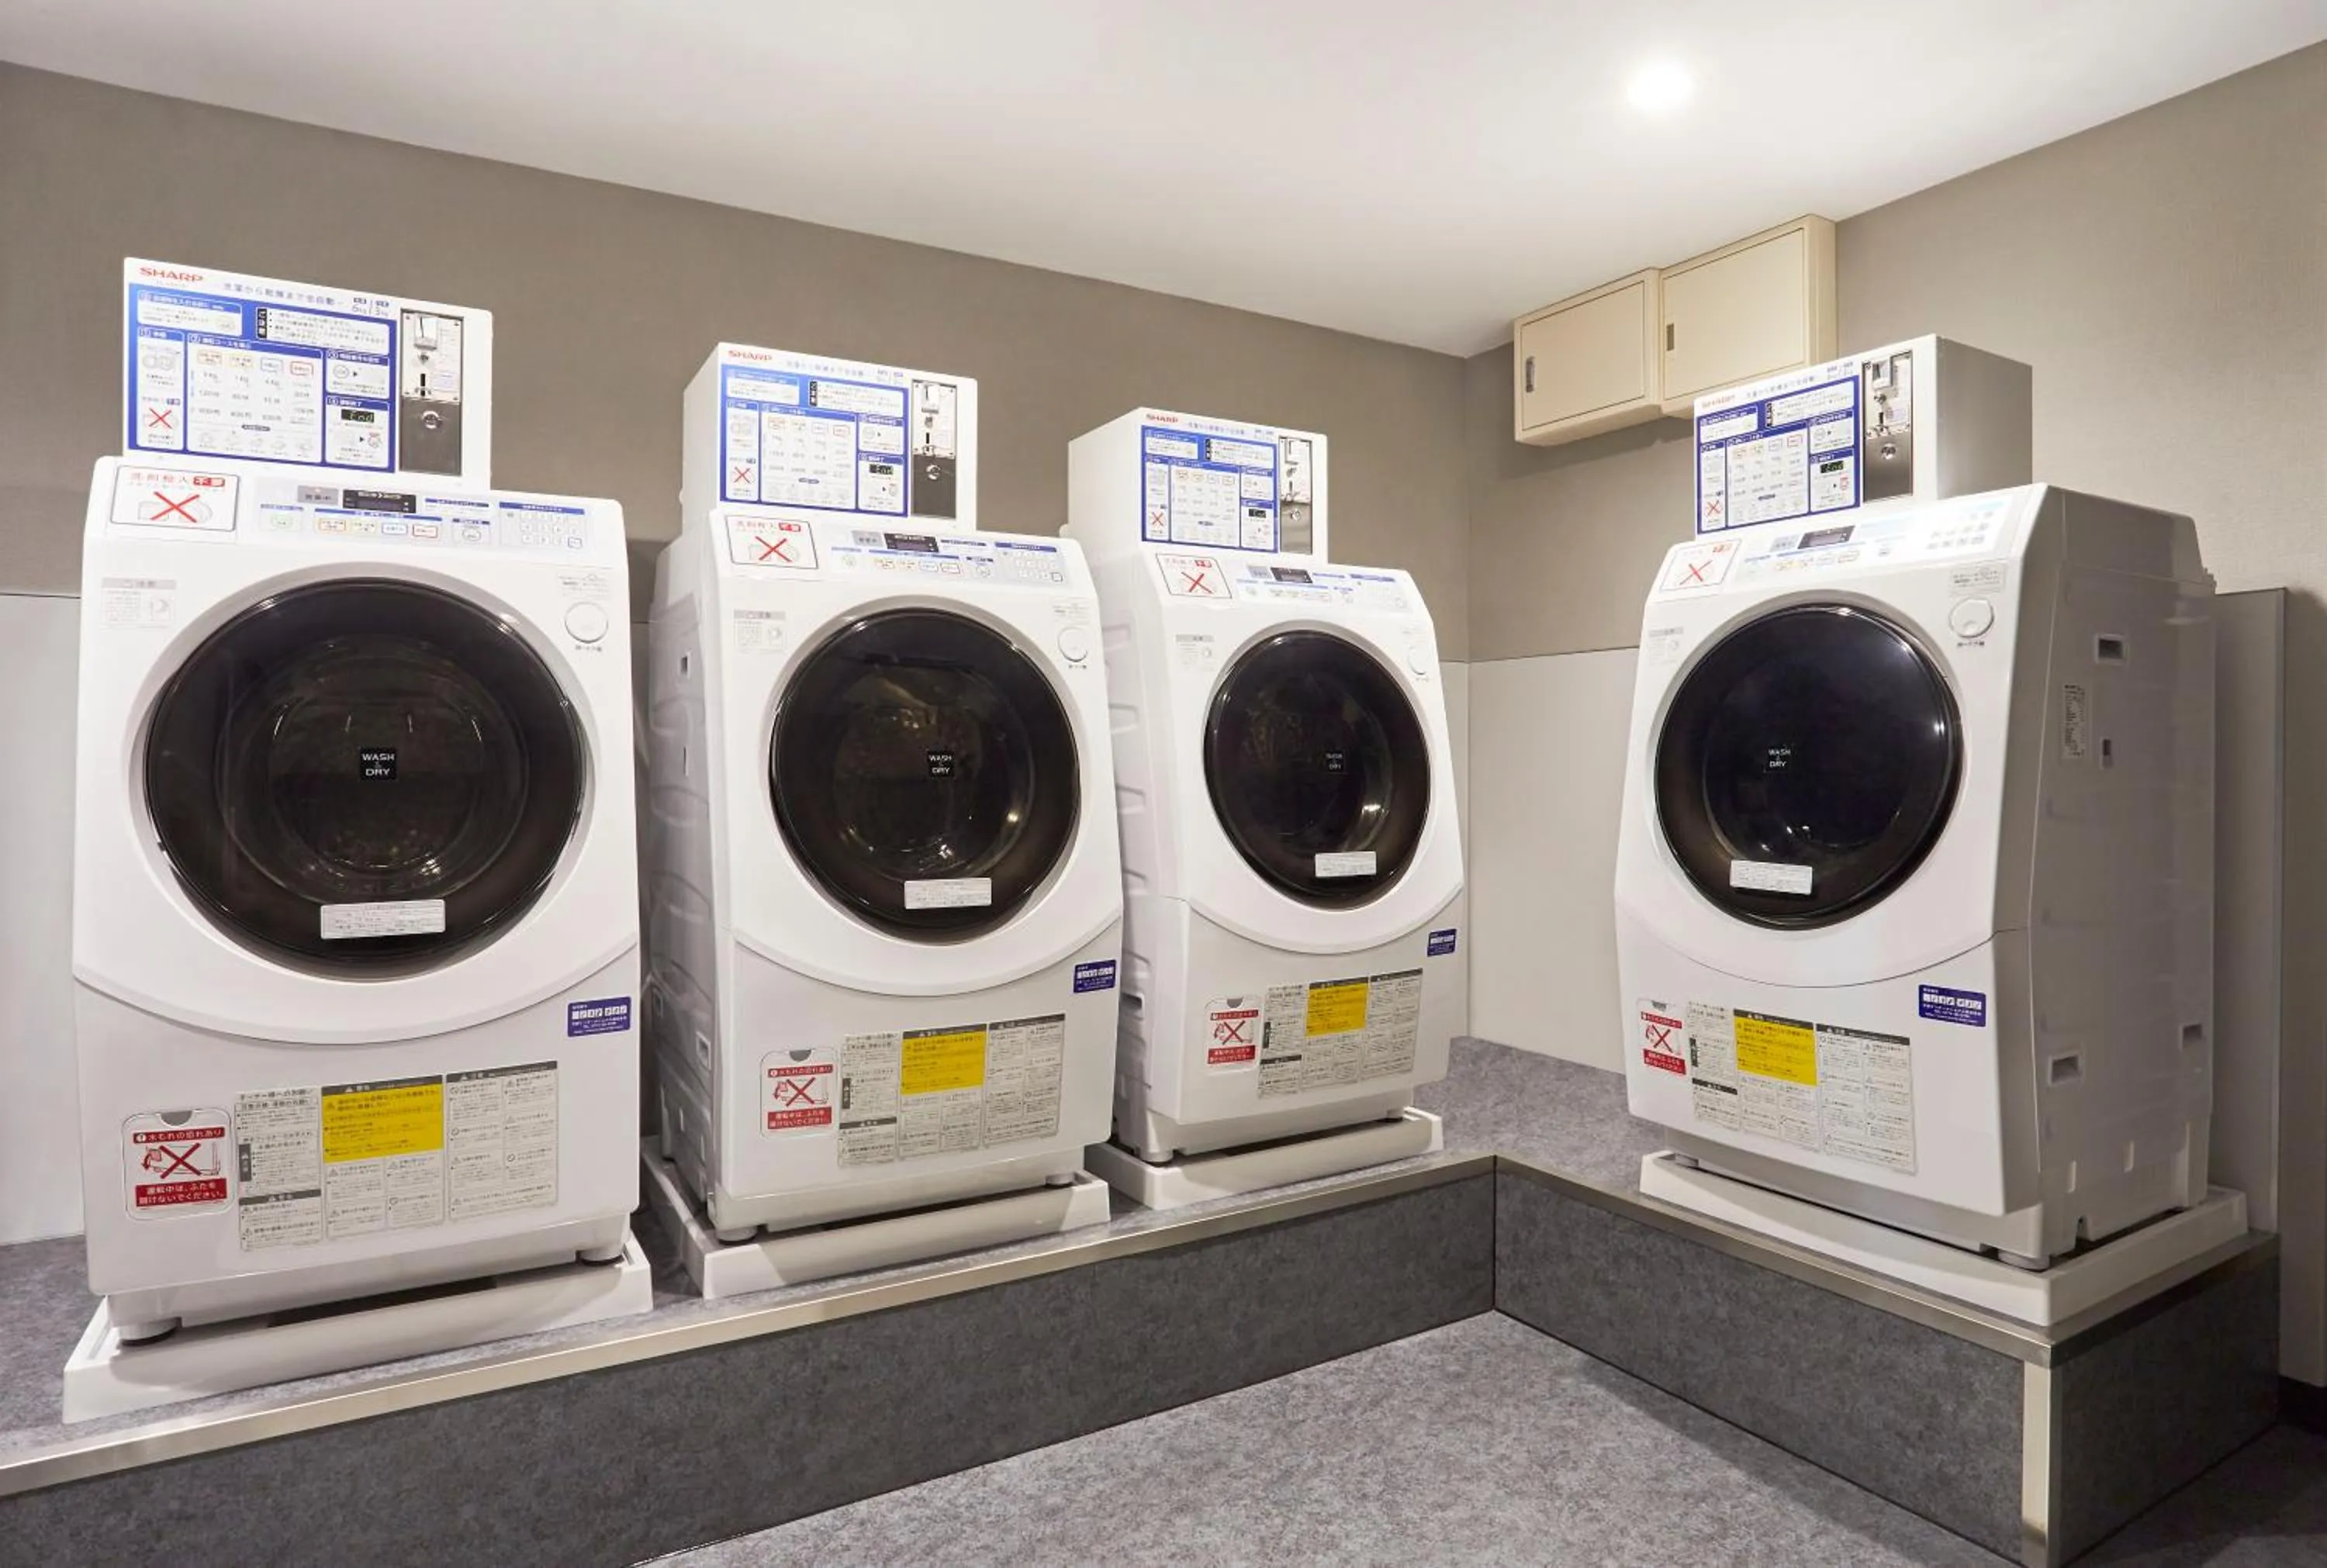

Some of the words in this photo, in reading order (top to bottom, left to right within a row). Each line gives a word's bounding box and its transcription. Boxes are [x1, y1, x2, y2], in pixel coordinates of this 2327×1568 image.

[140, 266, 204, 282] SHARP
[361, 753, 396, 762] WASH
[365, 768, 390, 776] DRY
